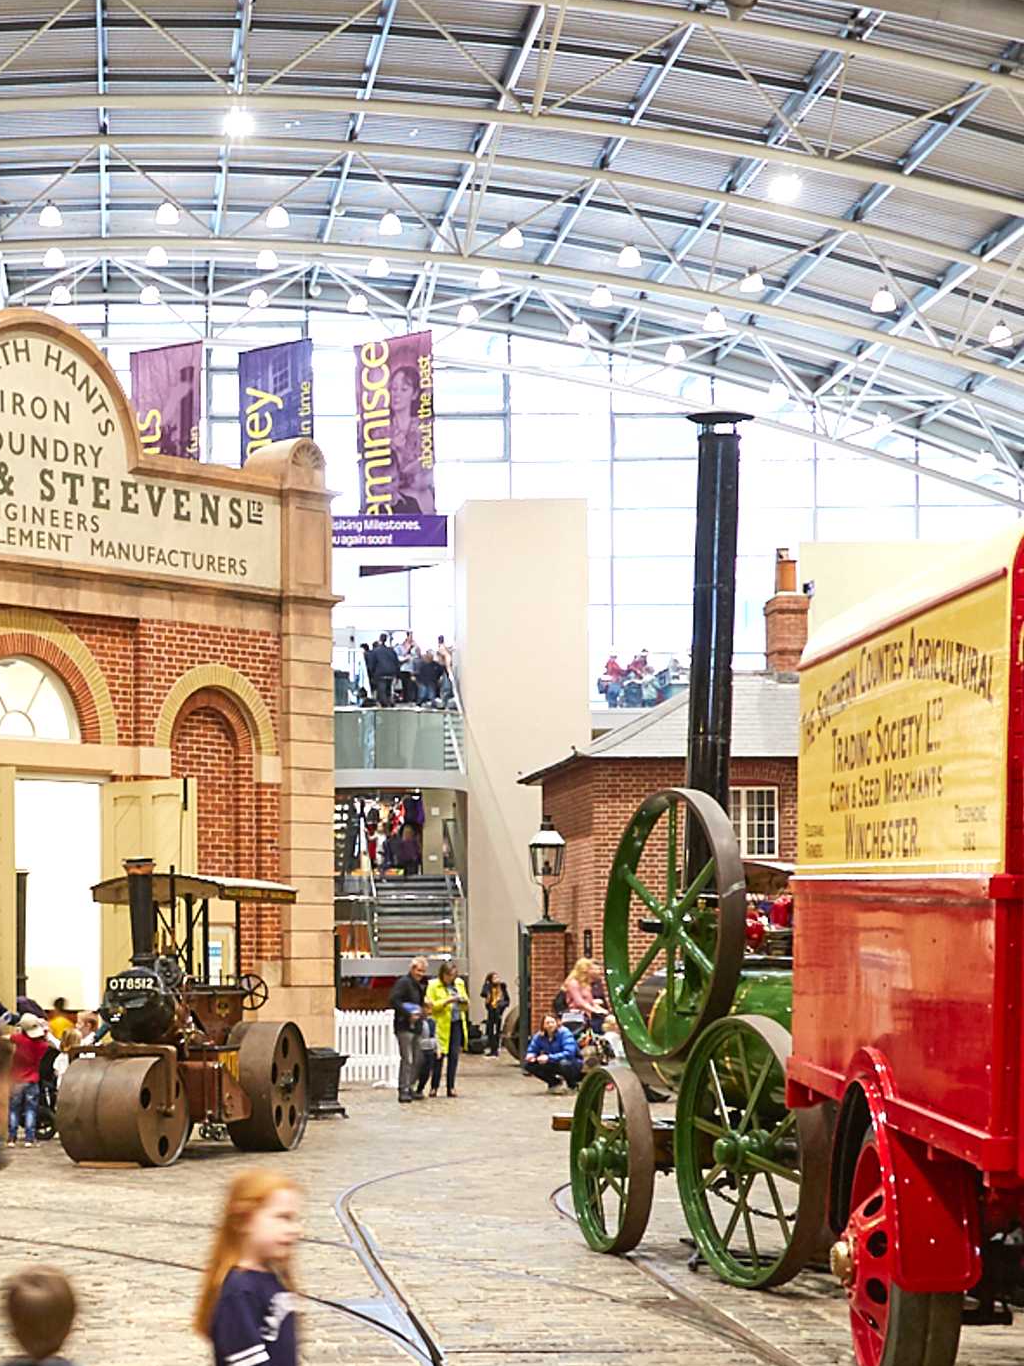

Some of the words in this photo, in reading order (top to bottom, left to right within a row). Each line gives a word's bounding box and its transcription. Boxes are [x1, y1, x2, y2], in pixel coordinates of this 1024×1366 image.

[418, 355, 433, 389] past
[0, 389, 70, 424] IRON
[44, 344, 115, 437] HANTS
[298, 381, 311, 416] time
[418, 393, 432, 418] the
[419, 419, 433, 469] about
[39, 468, 244, 529] STEEVENS
[90, 538, 248, 576] MANUFACTURERS
[876, 715, 923, 764] SOCIETY
[109, 978, 154, 990] OT8512
